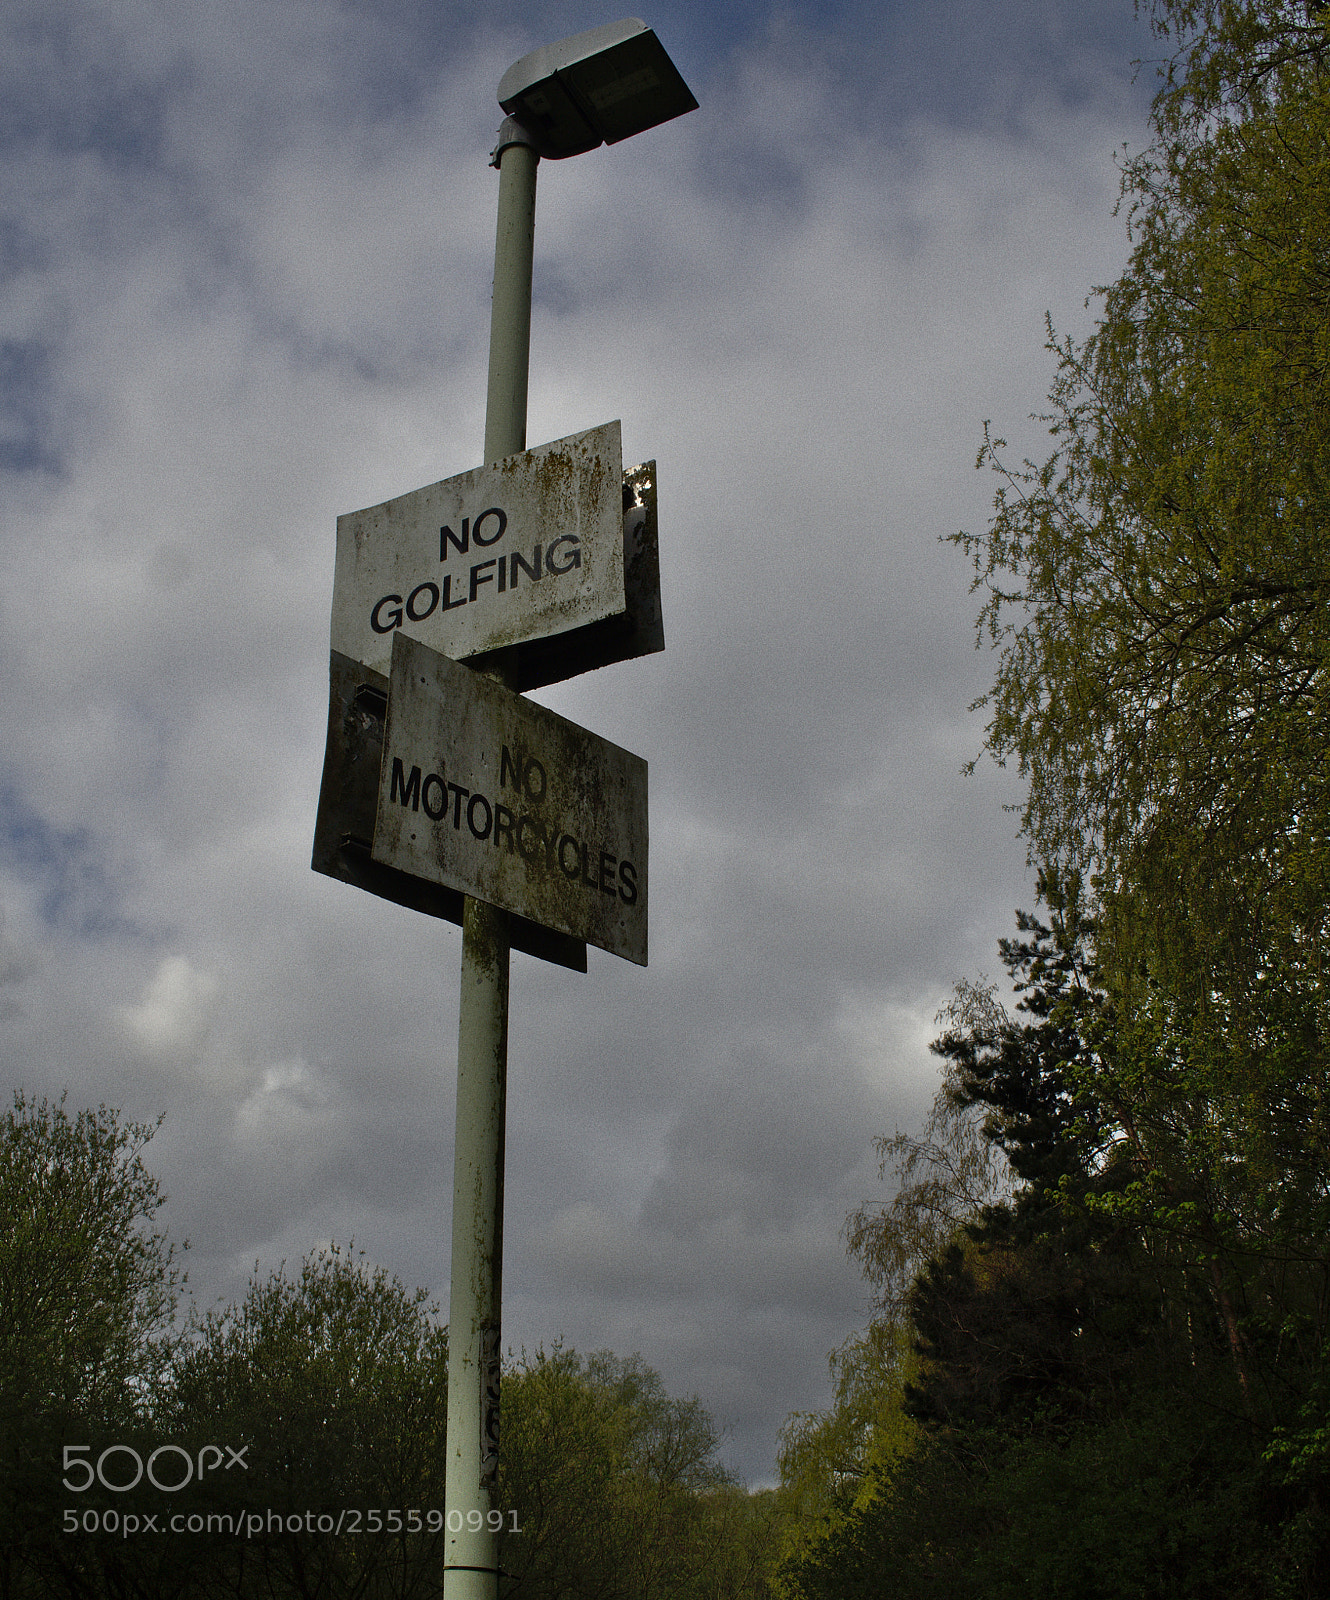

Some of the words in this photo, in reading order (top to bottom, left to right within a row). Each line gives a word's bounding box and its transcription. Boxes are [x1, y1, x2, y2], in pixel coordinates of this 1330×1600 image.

[439, 507, 508, 563] NO
[370, 534, 582, 634] GOLFING
[499, 744, 547, 801] NO
[389, 756, 639, 906] MOTORCYCLES
